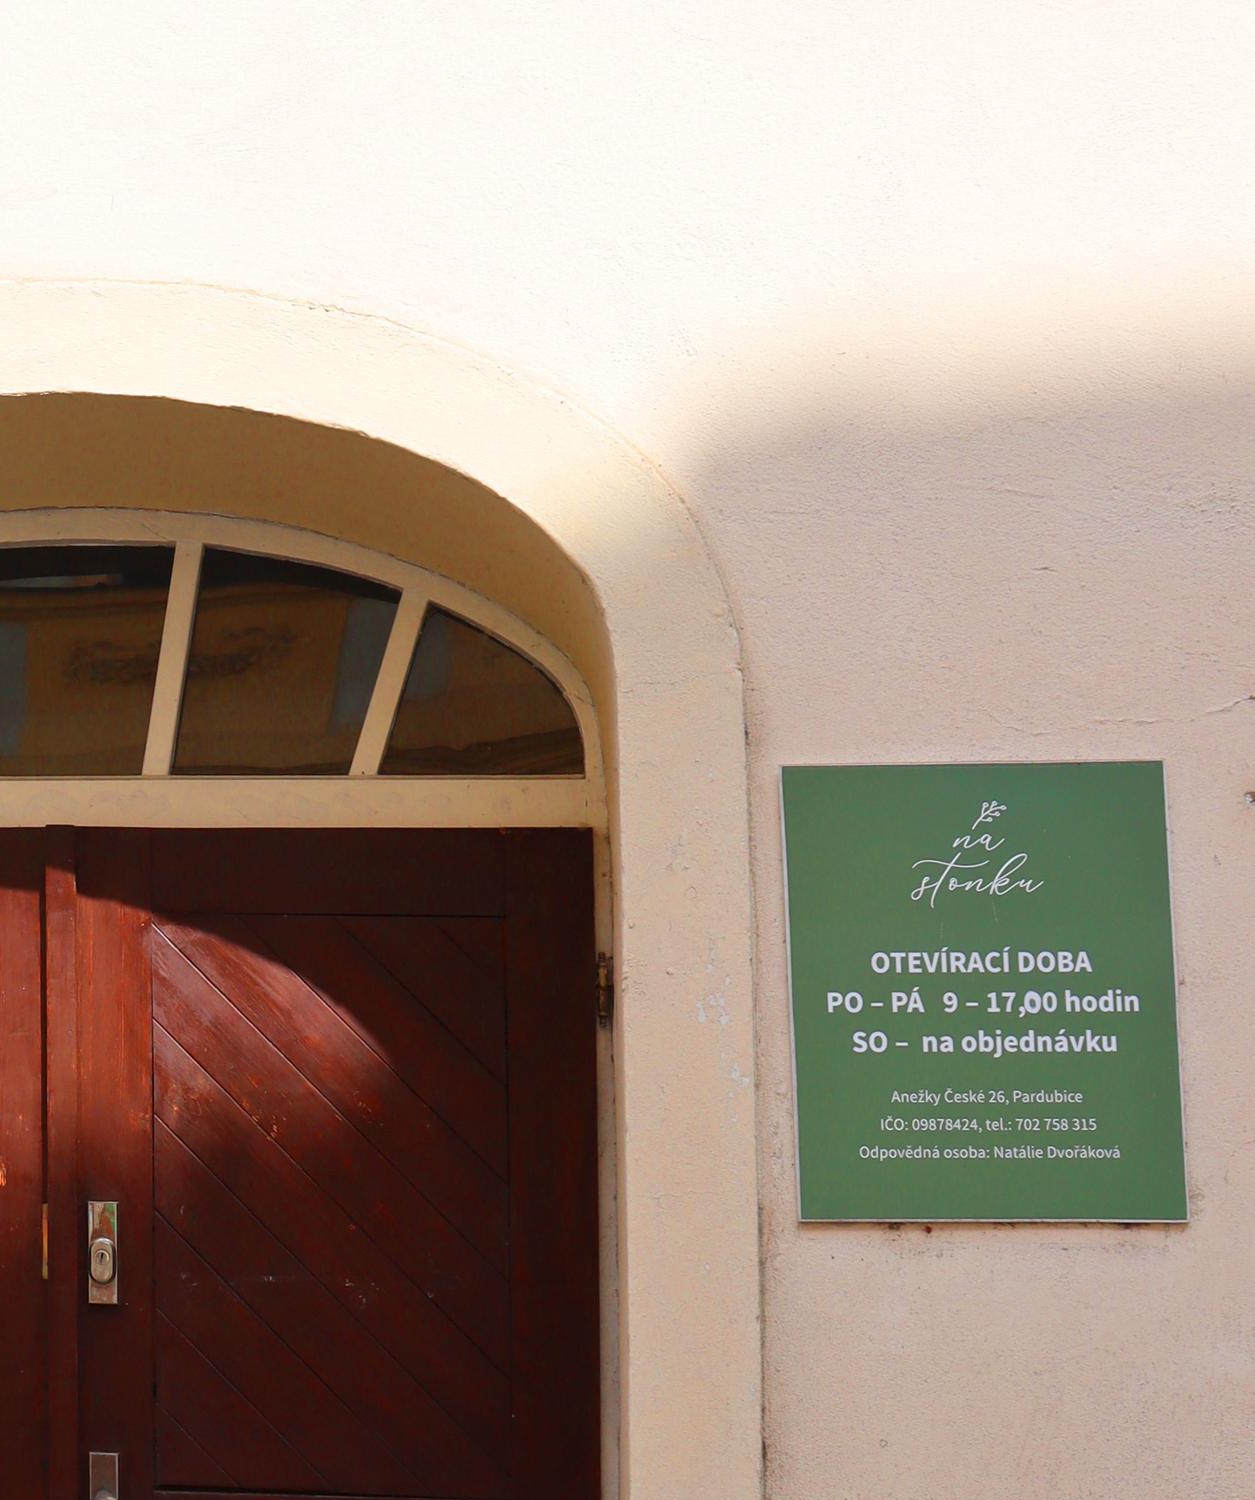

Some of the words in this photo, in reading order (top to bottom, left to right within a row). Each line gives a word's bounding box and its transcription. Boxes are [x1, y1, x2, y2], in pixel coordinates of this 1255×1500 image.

[870, 946, 1011, 974] OTEVÍRACÍ
[1018, 951, 1093, 973] DOBA
[827, 991, 864, 1014] PO
[891, 986, 925, 1014] PÁ
[943, 991, 958, 1014] 9
[1065, 991, 1140, 1013] hodin
[852, 1031, 888, 1053] SO
[922, 1035, 954, 1053] na
[961, 1031, 1118, 1058] objednávku
[891, 1089, 941, 1107] Anežky
[943, 1088, 985, 1104] České
[988, 1090, 1010, 1105] 26,
[1013, 1090, 1083, 1104] Pardubice
[880, 1117, 909, 1132] IČO:
[911, 1118, 983, 1133] 09878424,
[985, 1118, 1012, 1132] tel.:
[1015, 1118, 1040, 1131] 702
[1044, 1118, 1069, 1131] 758
[1072, 1118, 1097, 1131] 315
[859, 1145, 940, 1162] Odpovědná
[943, 1146, 990, 1160] osoba:
[993, 1146, 1044, 1160] Natálie
[1047, 1146, 1121, 1160] Dvořáková
